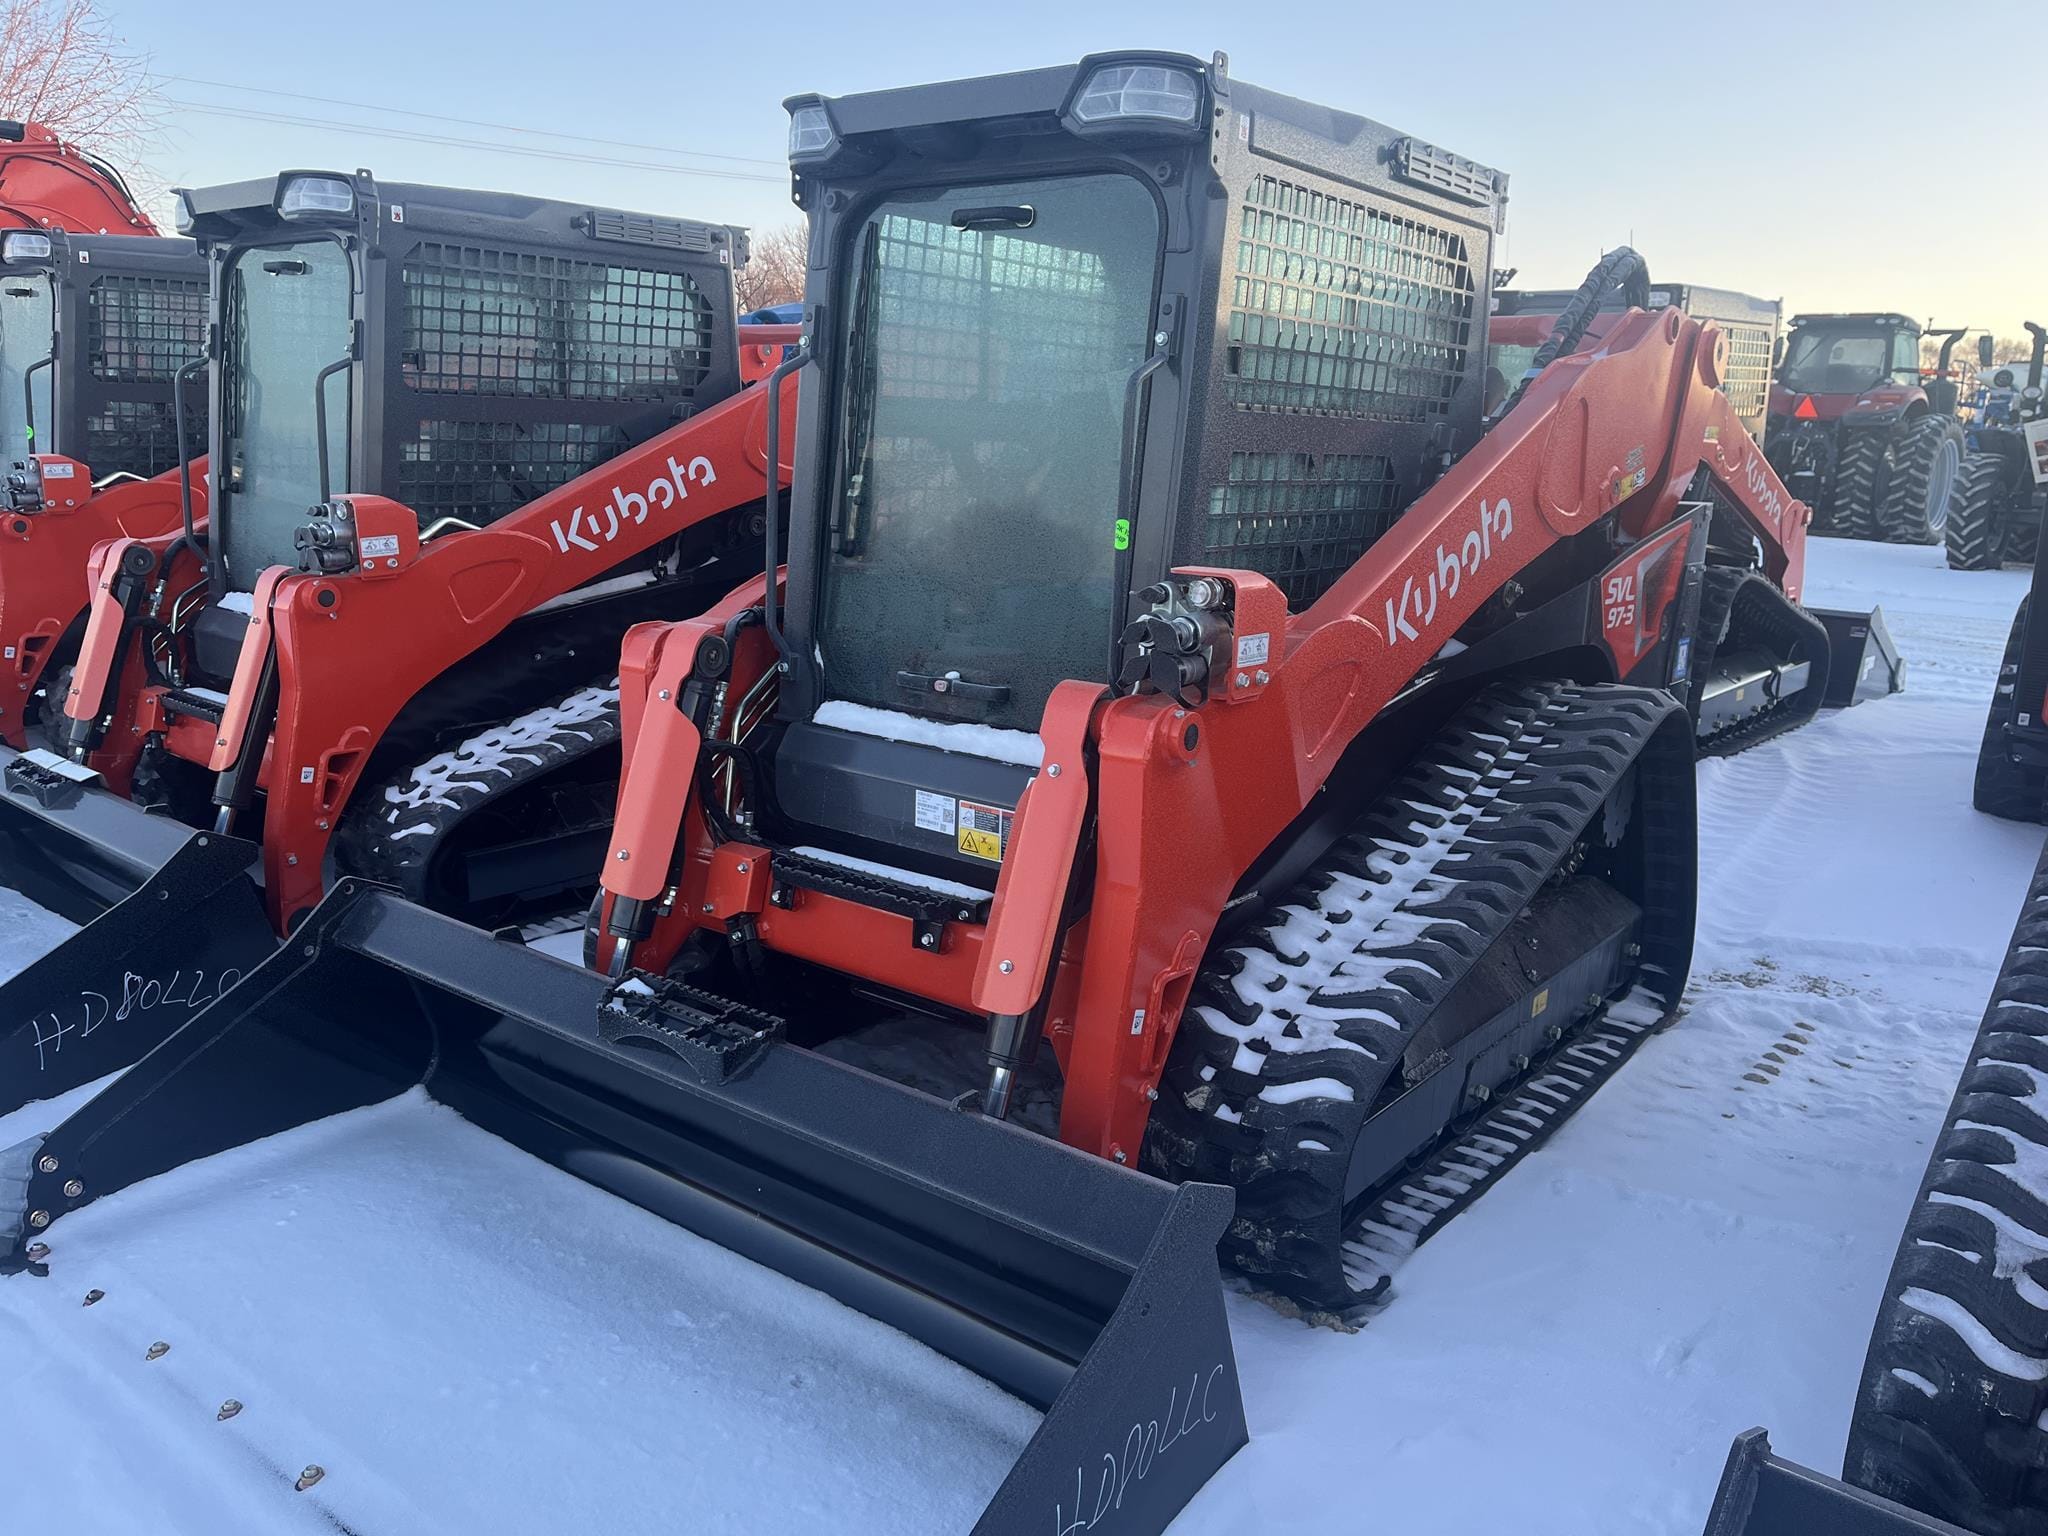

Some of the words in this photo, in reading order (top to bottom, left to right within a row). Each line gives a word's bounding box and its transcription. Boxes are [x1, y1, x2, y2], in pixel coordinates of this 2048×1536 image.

[550, 456, 717, 554] Kubota
[1746, 452, 1781, 526] Kubota
[1385, 497, 1513, 647] Kubota
[1604, 575, 1636, 605] SVL
[1606, 603, 1636, 630] 97-3
